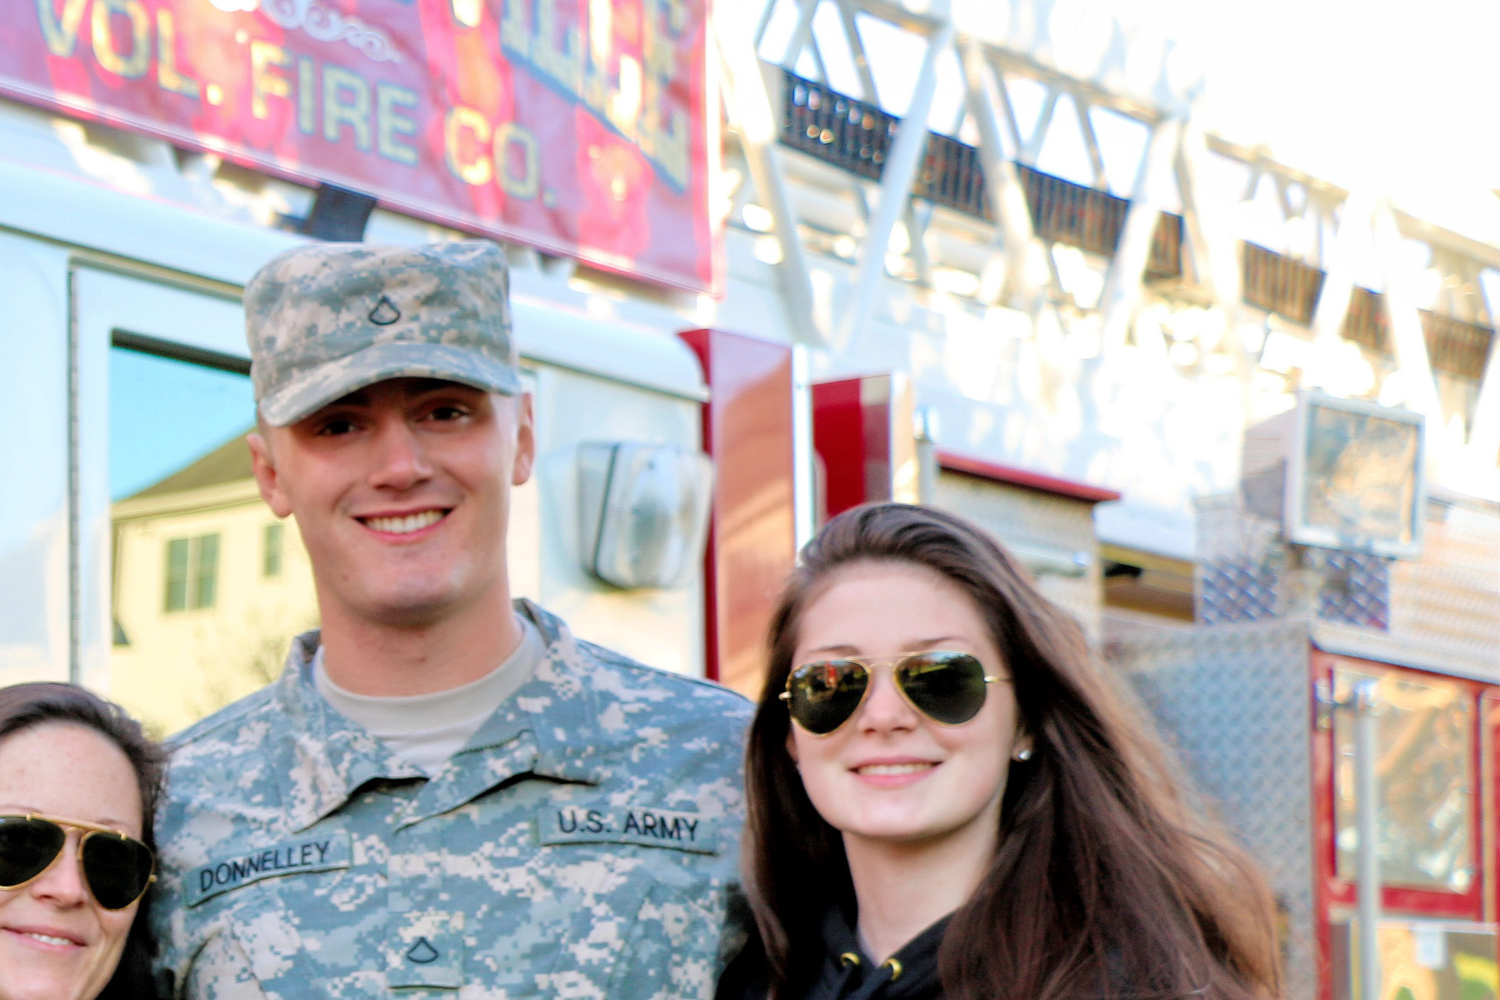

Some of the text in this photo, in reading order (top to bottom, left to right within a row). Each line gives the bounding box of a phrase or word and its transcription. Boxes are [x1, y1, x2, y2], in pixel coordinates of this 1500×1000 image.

[35, 0, 559, 209] VOL. FIRE CO.
[556, 809, 699, 842] U.S. ARMY
[199, 840, 330, 893] DONNELLEY
